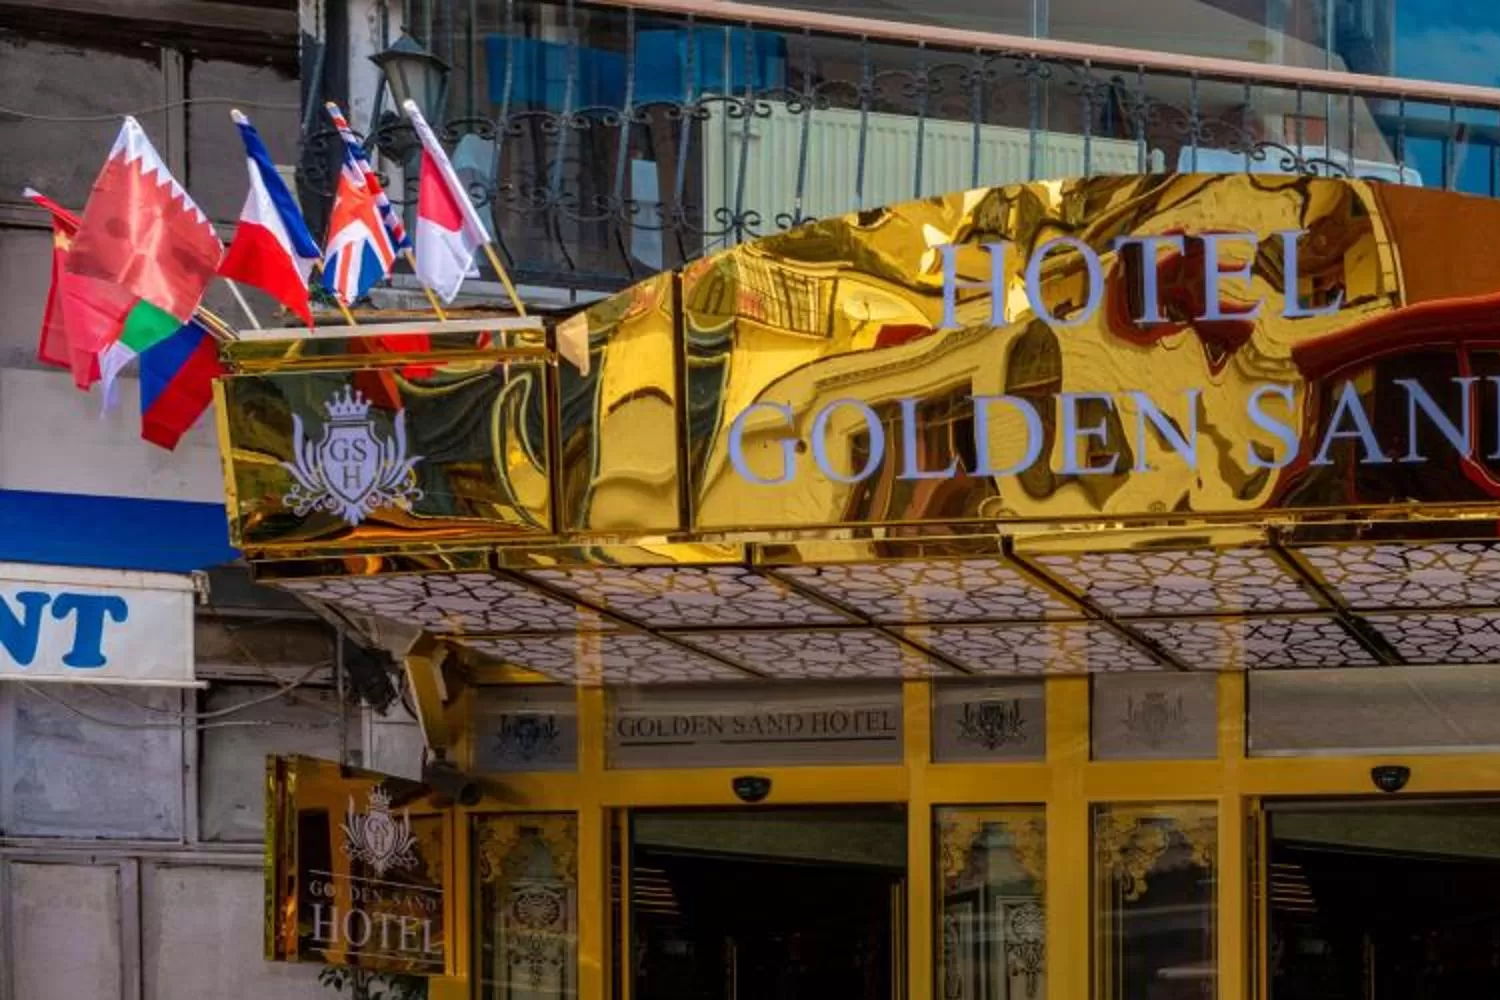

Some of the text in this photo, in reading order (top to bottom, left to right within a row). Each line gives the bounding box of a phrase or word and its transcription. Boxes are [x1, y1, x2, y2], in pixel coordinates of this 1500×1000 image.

[934, 229, 1346, 330] HOTEL
[329, 437, 368, 463] GS
[728, 390, 1200, 485] GOLDEN
[342, 464, 362, 490] H
[0, 590, 129, 669] NT
[616, 709, 897, 737] GOLDEN SAND HOTEL
[309, 880, 383, 904] GODEN
[310, 903, 445, 954] HOTEL
